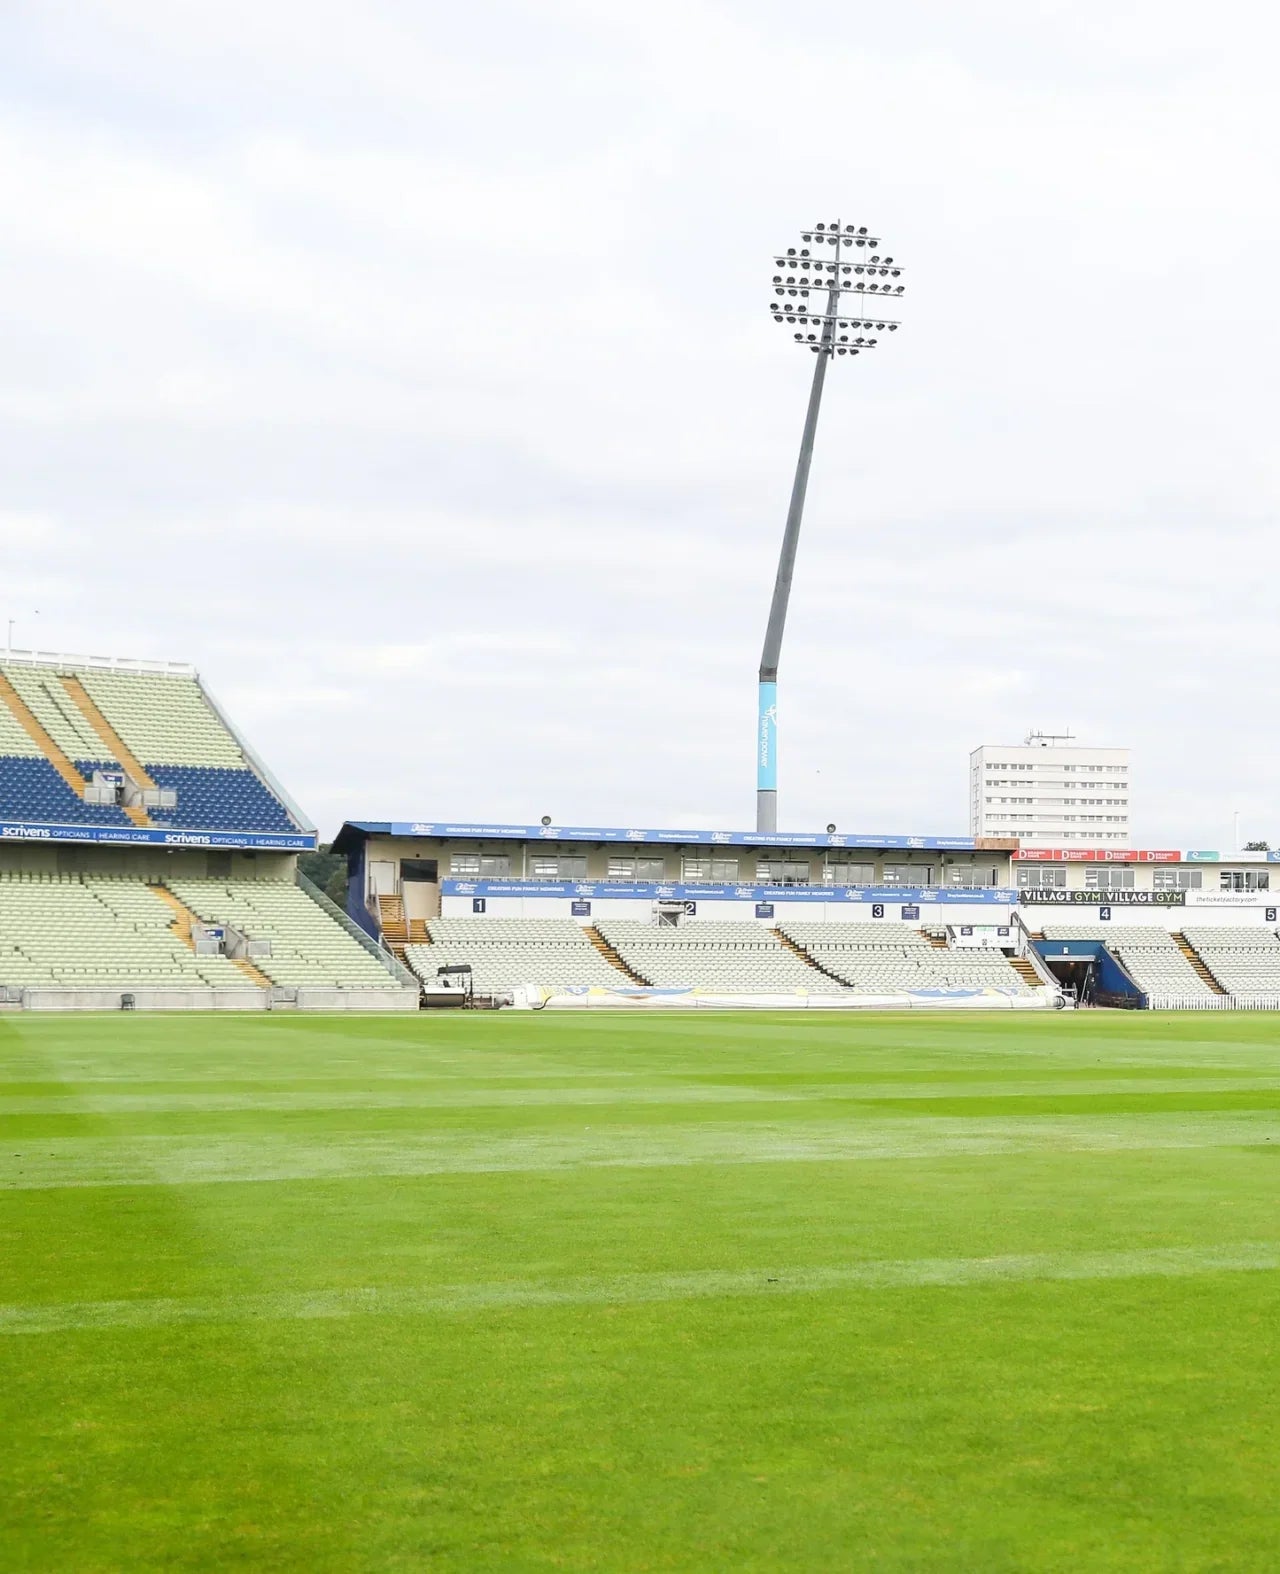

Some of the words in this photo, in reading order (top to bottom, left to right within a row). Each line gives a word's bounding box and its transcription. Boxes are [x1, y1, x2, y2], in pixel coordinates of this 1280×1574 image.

[2, 826, 51, 838] scrivens
[165, 832, 210, 844] scrivens
[1025, 892, 1072, 901] VILLAGE
[1074, 893, 1100, 901] GYM
[1107, 892, 1152, 901] VILLAGE
[1156, 893, 1182, 901] GYM
[476, 900, 483, 912] 1
[686, 903, 695, 915] 2
[874, 906, 882, 917] 3
[1101, 909, 1109, 919] 4
[1267, 910, 1275, 920] 5
